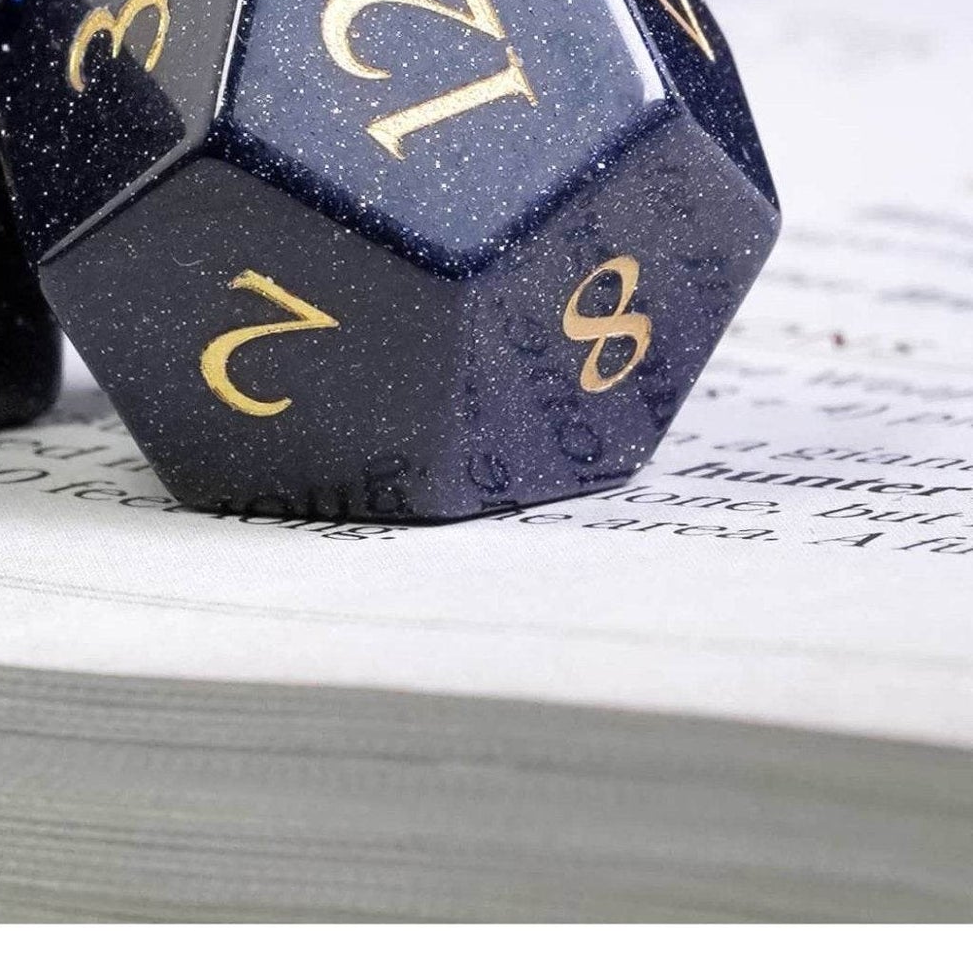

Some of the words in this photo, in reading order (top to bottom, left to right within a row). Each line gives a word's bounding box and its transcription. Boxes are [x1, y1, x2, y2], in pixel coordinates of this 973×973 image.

[200, 269, 341, 417] 2
[563, 254, 653, 394] 8
[580, 516, 780, 541] area.
[802, 530, 886, 548] A
[813, 502, 964, 525] but
